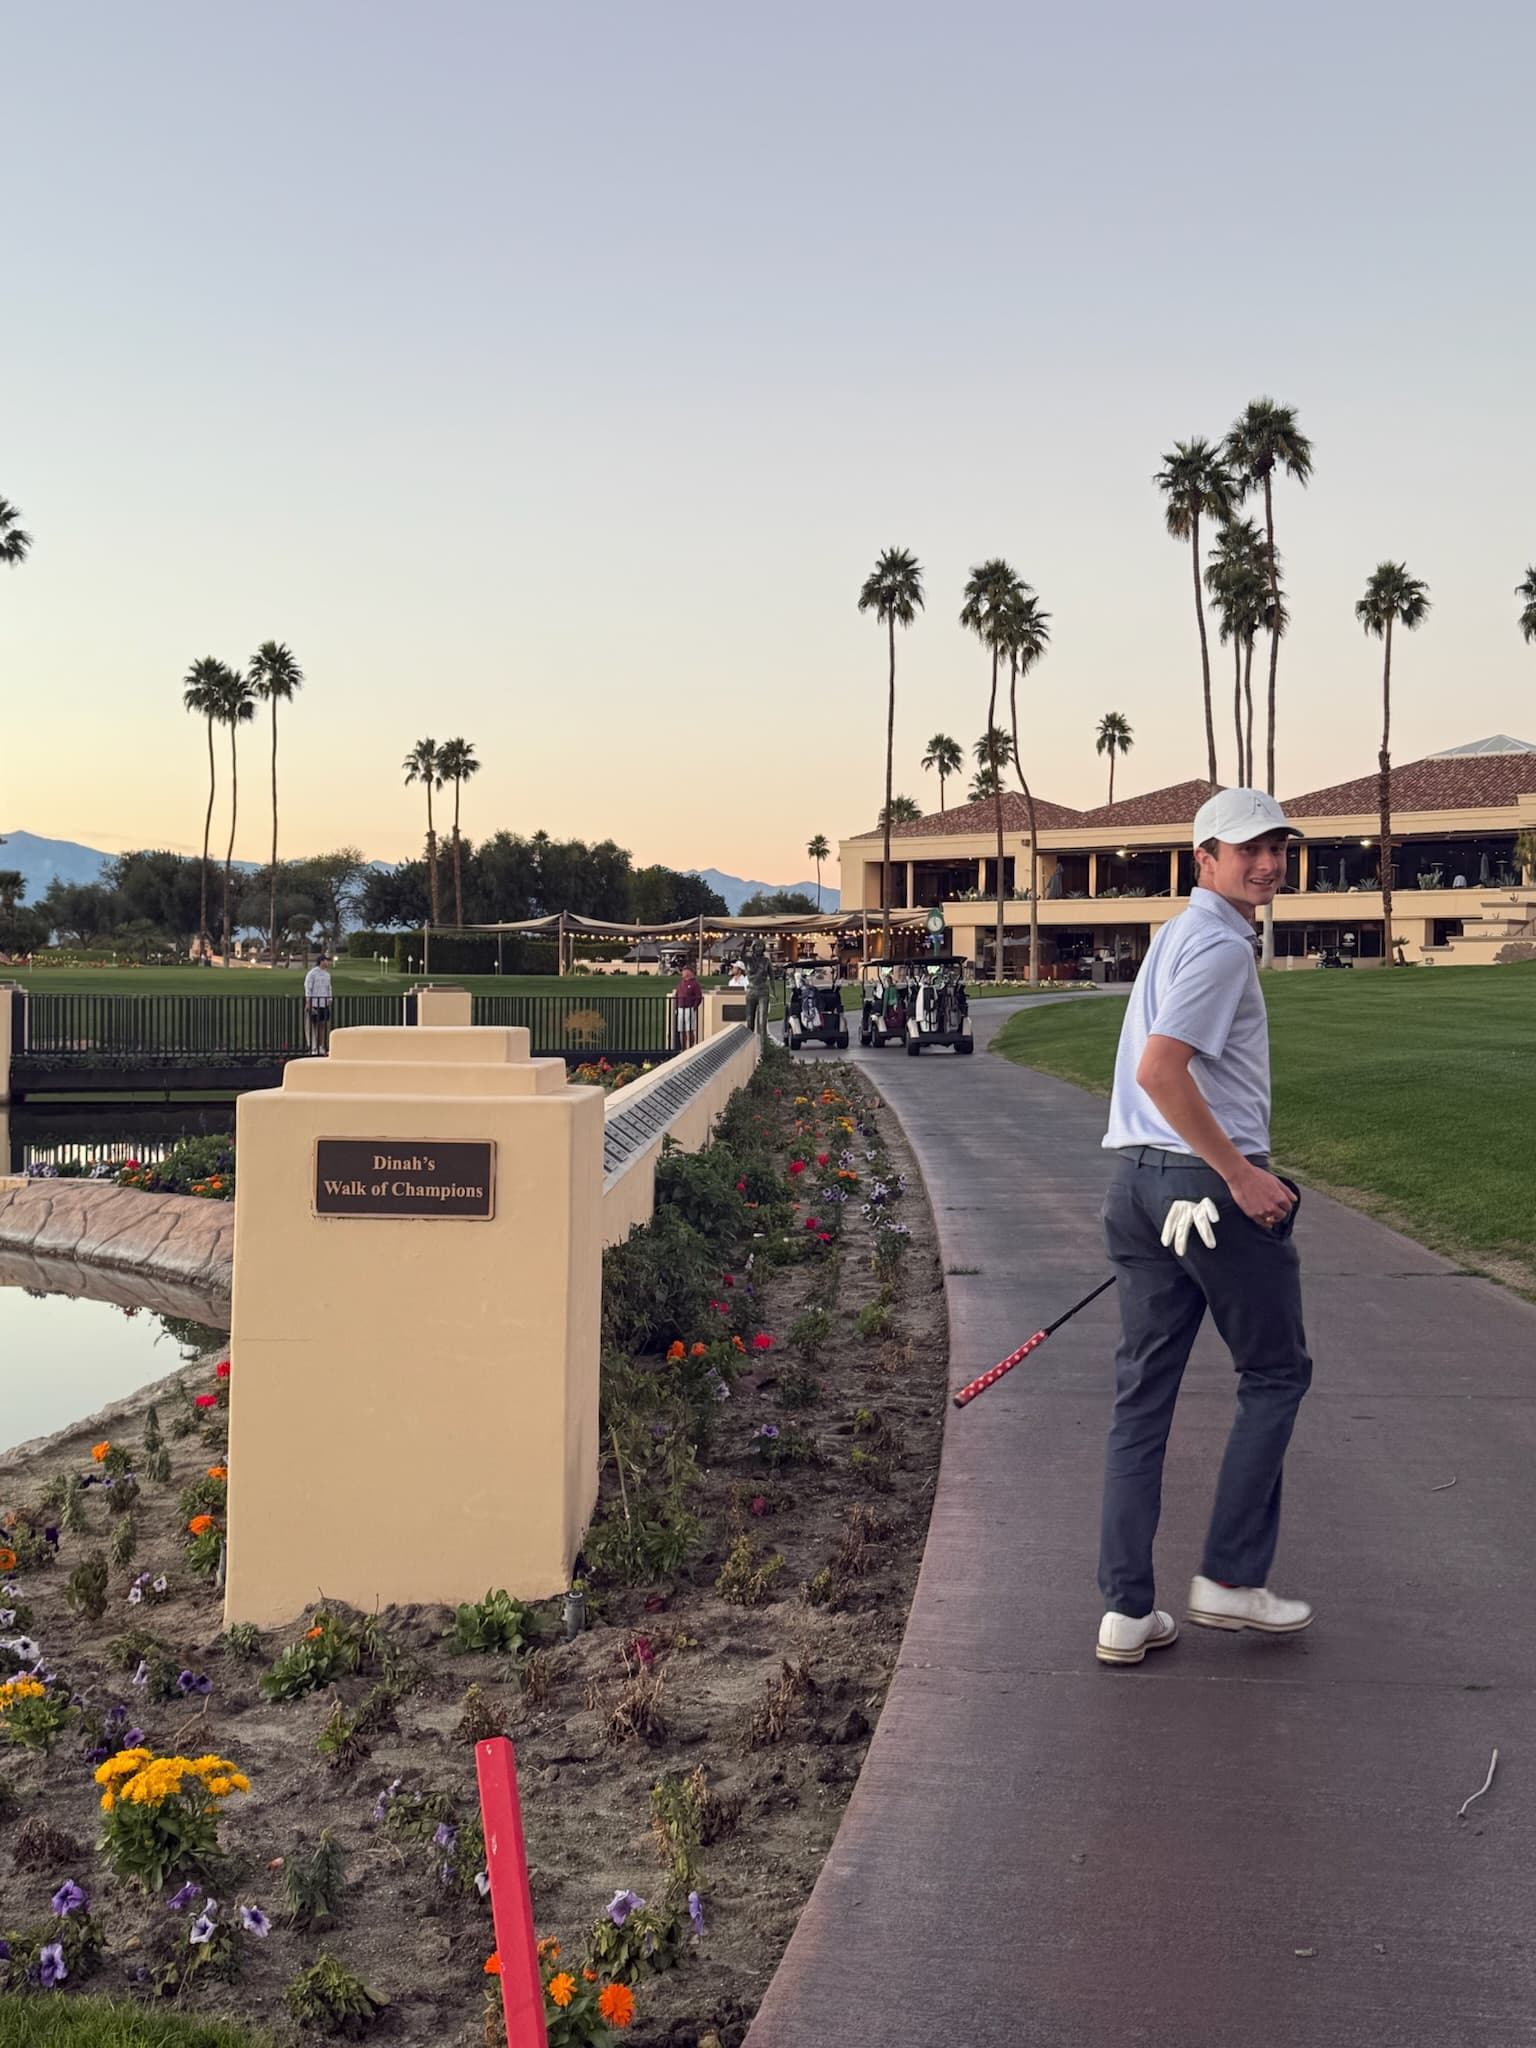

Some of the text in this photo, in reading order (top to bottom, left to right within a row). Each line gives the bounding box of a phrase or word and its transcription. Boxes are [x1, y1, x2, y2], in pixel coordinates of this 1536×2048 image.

[373, 1155, 436, 1171] Dinah’s
[324, 1181, 484, 1201] Walk of Champions
